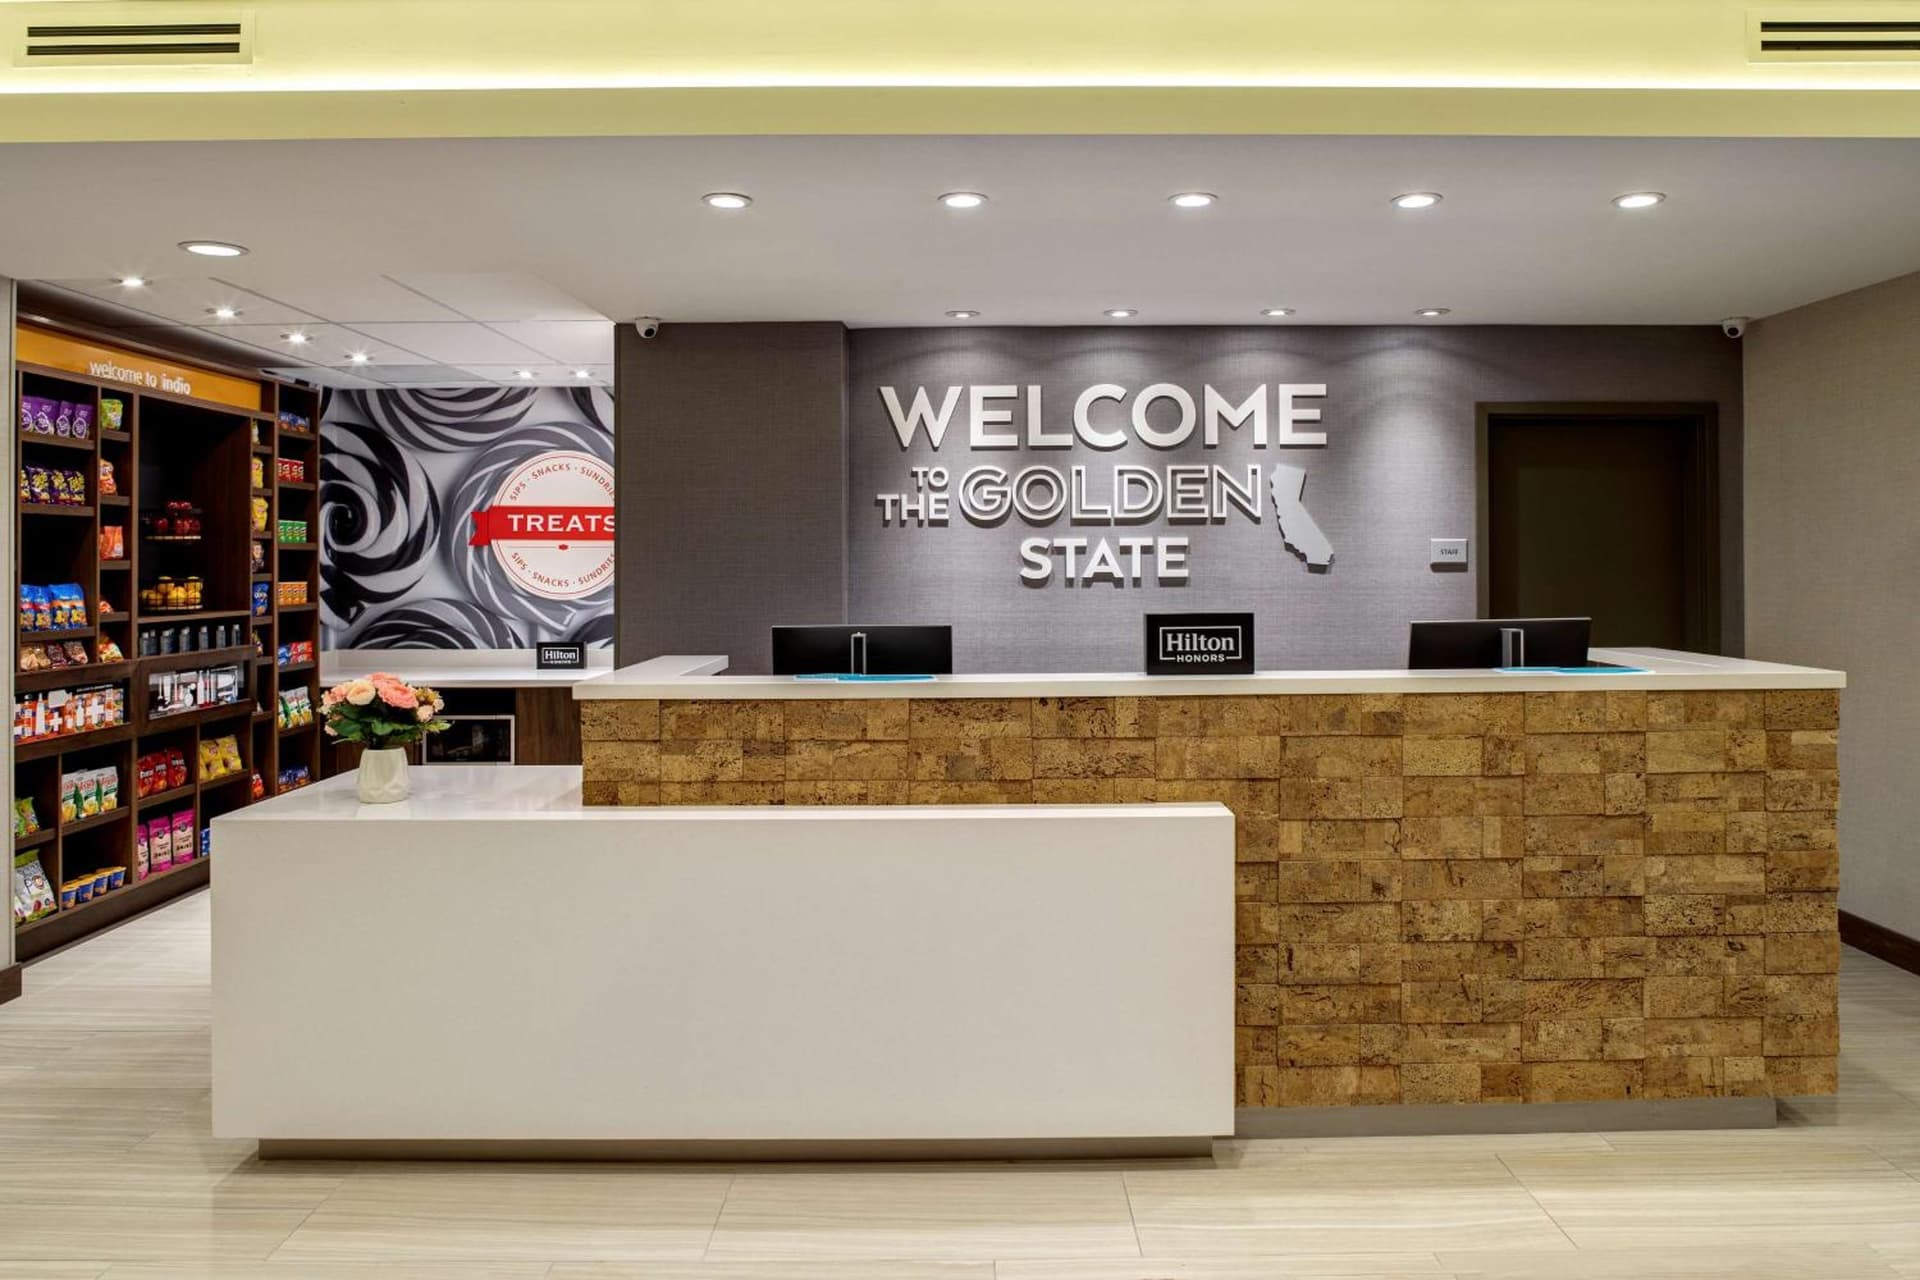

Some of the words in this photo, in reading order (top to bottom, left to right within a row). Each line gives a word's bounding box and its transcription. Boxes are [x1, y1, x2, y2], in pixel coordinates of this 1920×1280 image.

[89, 361, 143, 385] welcome
[145, 371, 157, 388] to
[161, 373, 191, 395] indio
[880, 383, 1328, 449] WELCOME
[510, 481, 527, 501] SIPS
[531, 463, 571, 480] SNACKS
[877, 494, 949, 521] THE
[958, 464, 1262, 522] GOLDEN
[911, 466, 949, 488] TO
[507, 514, 615, 532] TREATS
[511, 552, 528, 571] SIPS
[532, 571, 569, 587] SNACKS
[1020, 537, 1189, 580] STATE
[545, 650, 576, 660] Hilton
[1166, 633, 1235, 652] Hilton
[1176, 654, 1225, 663] HONORS
